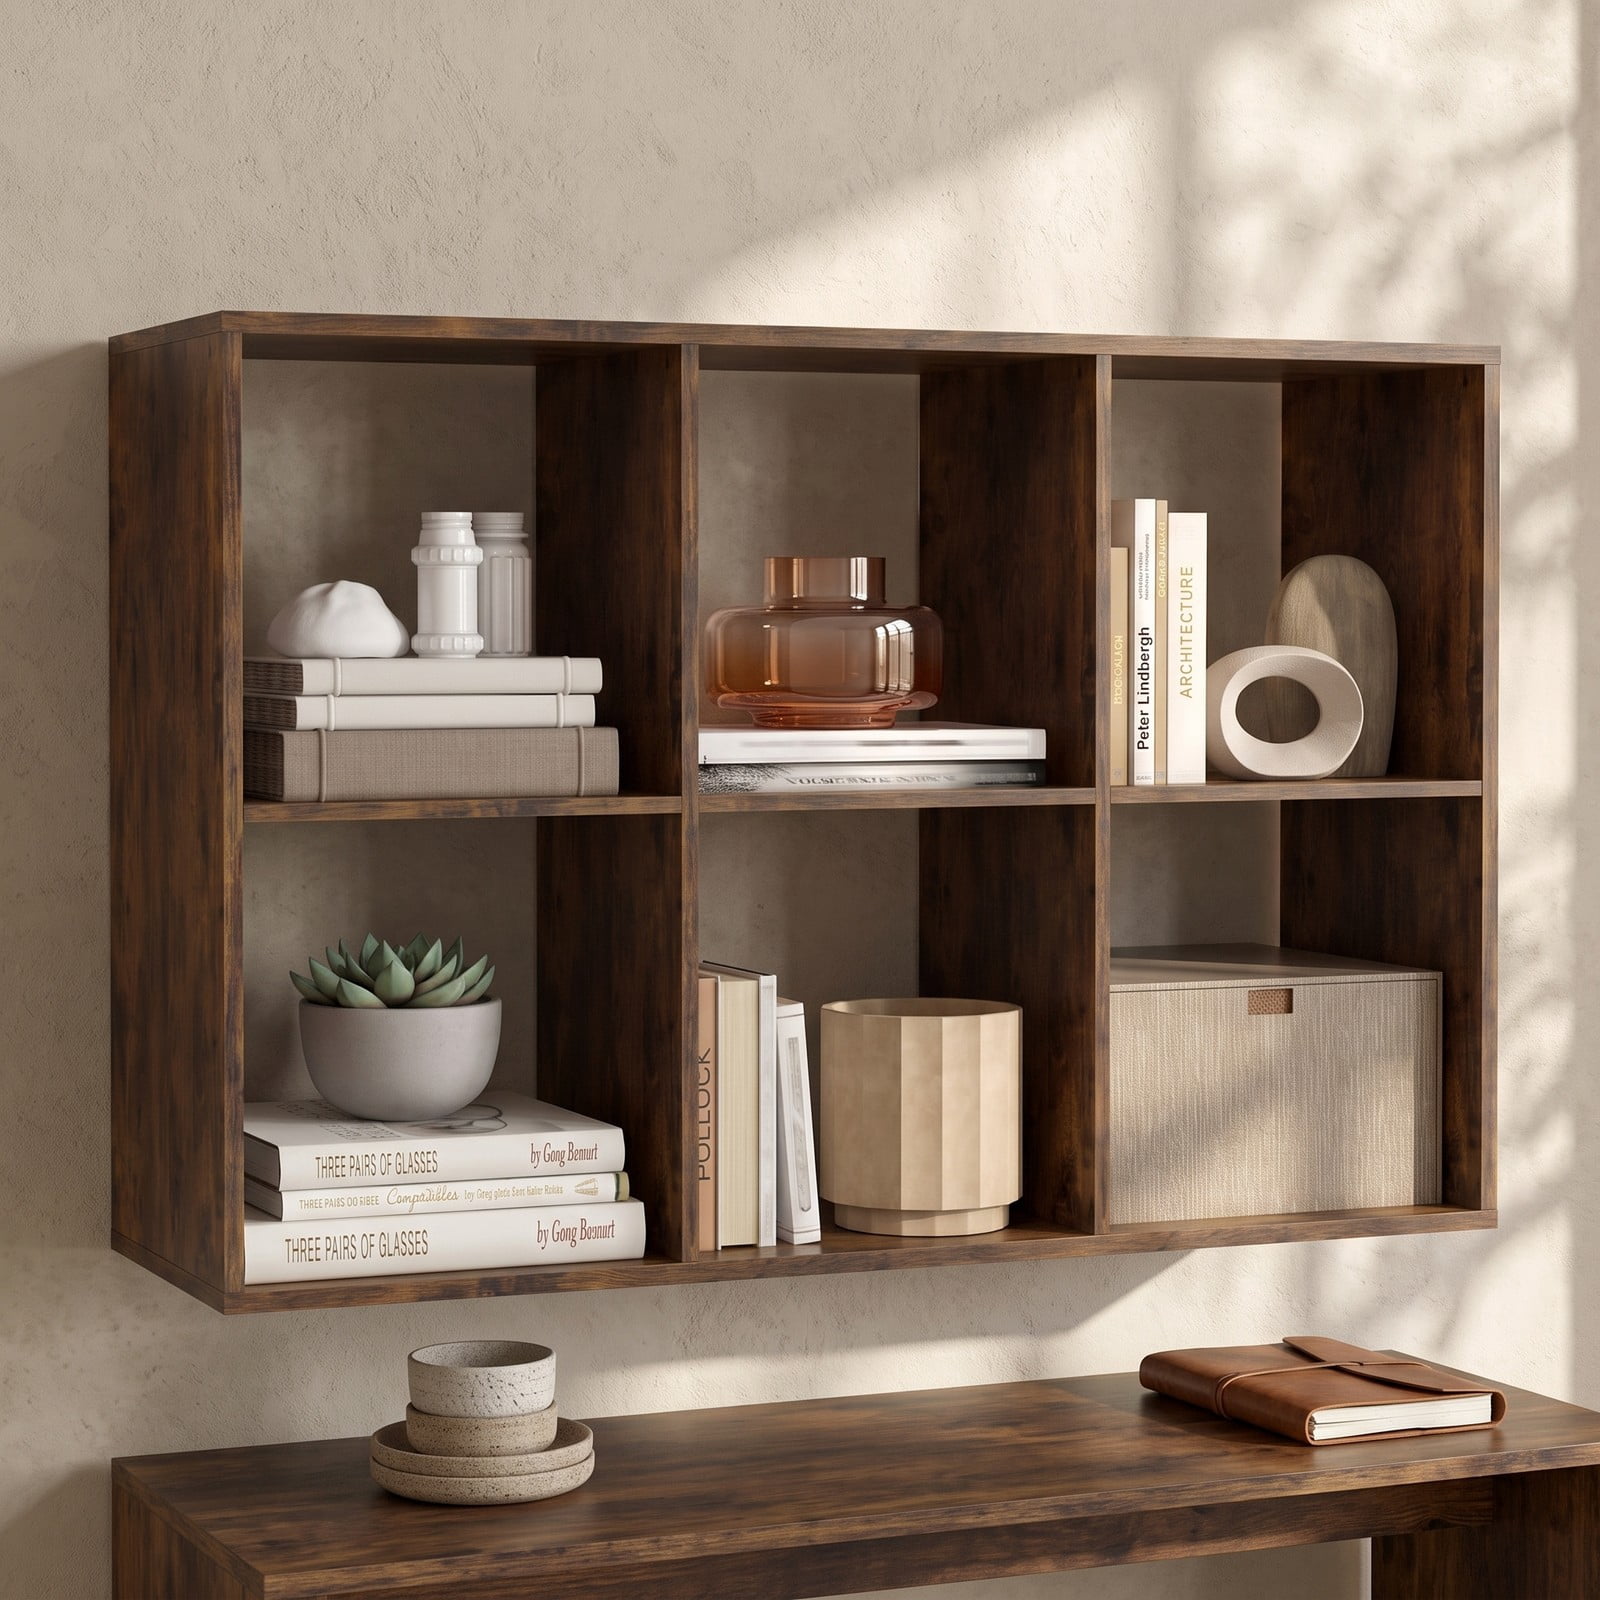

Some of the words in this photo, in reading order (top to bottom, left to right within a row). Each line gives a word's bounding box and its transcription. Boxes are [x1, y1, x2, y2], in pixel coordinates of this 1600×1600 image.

[1180, 566, 1193, 699] ARCHITECTURE
[1137, 627, 1153, 704] Lindbergh
[1137, 710, 1150, 751] Peter
[315, 1155, 346, 1179] THREE
[349, 1153, 377, 1177] PAIRS
[380, 1152, 392, 1176] OF
[395, 1150, 439, 1175] GLASSES
[531, 1142, 542, 1169] by
[543, 1142, 566, 1168] Gong
[299, 1198, 323, 1210] THREE
[285, 1237, 321, 1263] THREE
[325, 1234, 357, 1261] PAIRS
[361, 1233, 375, 1259] OF
[379, 1229, 429, 1258] GLASSES
[537, 1220, 549, 1250] by
[551, 1219, 577, 1248] Gong
